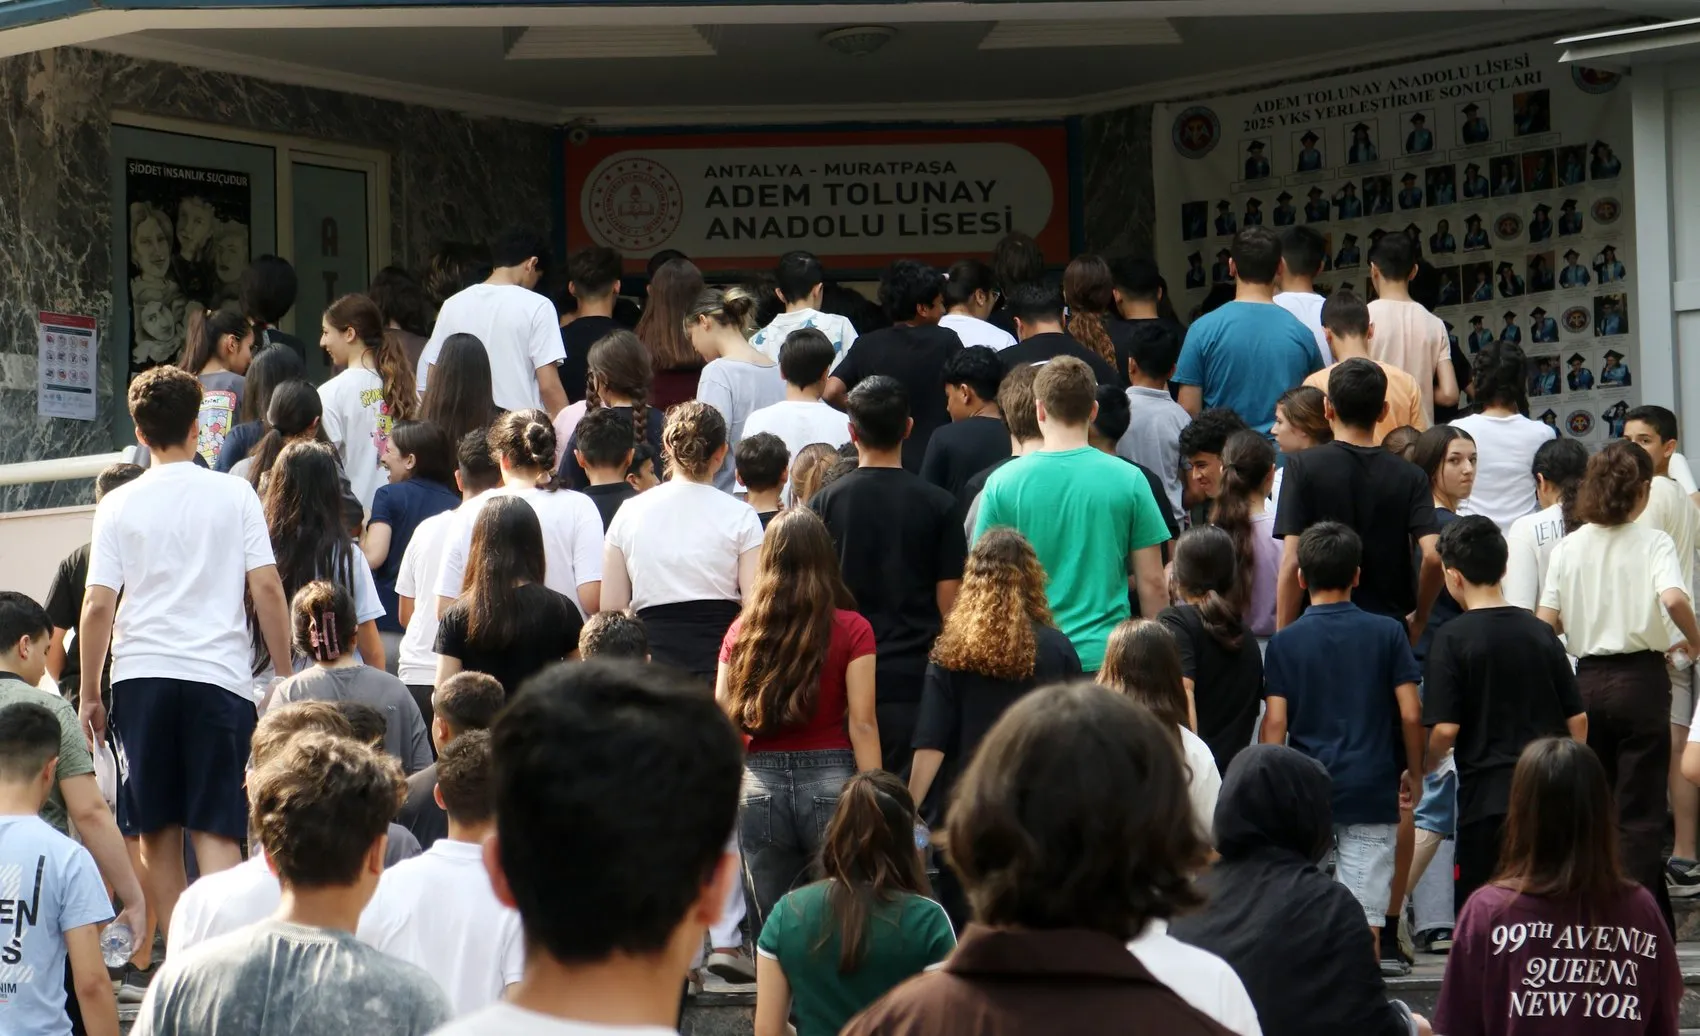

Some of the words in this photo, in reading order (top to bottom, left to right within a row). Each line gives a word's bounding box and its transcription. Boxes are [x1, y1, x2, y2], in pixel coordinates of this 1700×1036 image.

[1252, 95, 1300, 115] ADEM
[1304, 81, 1383, 106] TOLUNAY
[1387, 65, 1471, 91] ANADOLU
[1474, 53, 1531, 77] LİSESİ
[1243, 117, 1276, 133] 2025
[1279, 110, 1311, 127] YKS
[1314, 88, 1436, 121] YERLEŞTİRME
[1439, 70, 1543, 100] SONUÇLARI
[129, 160, 161, 176] ŞİDDET
[163, 167, 205, 182] İNSANLIK
[206, 172, 248, 187] SUÇUDUR
[704, 163, 803, 178] ANTALYA
[825, 160, 957, 176] MURATPAŞA
[705, 182, 810, 208] ADEM
[823, 179, 997, 206] TOLUNAY
[706, 214, 885, 240] ANADOLU
[898, 205, 1013, 236] LİSESİ
[1552, 924, 1658, 960] AVENUE
[1522, 957, 1638, 988] QUEENS
[1508, 990, 1577, 1019] NEW
[1582, 992, 1641, 1021] YOR
